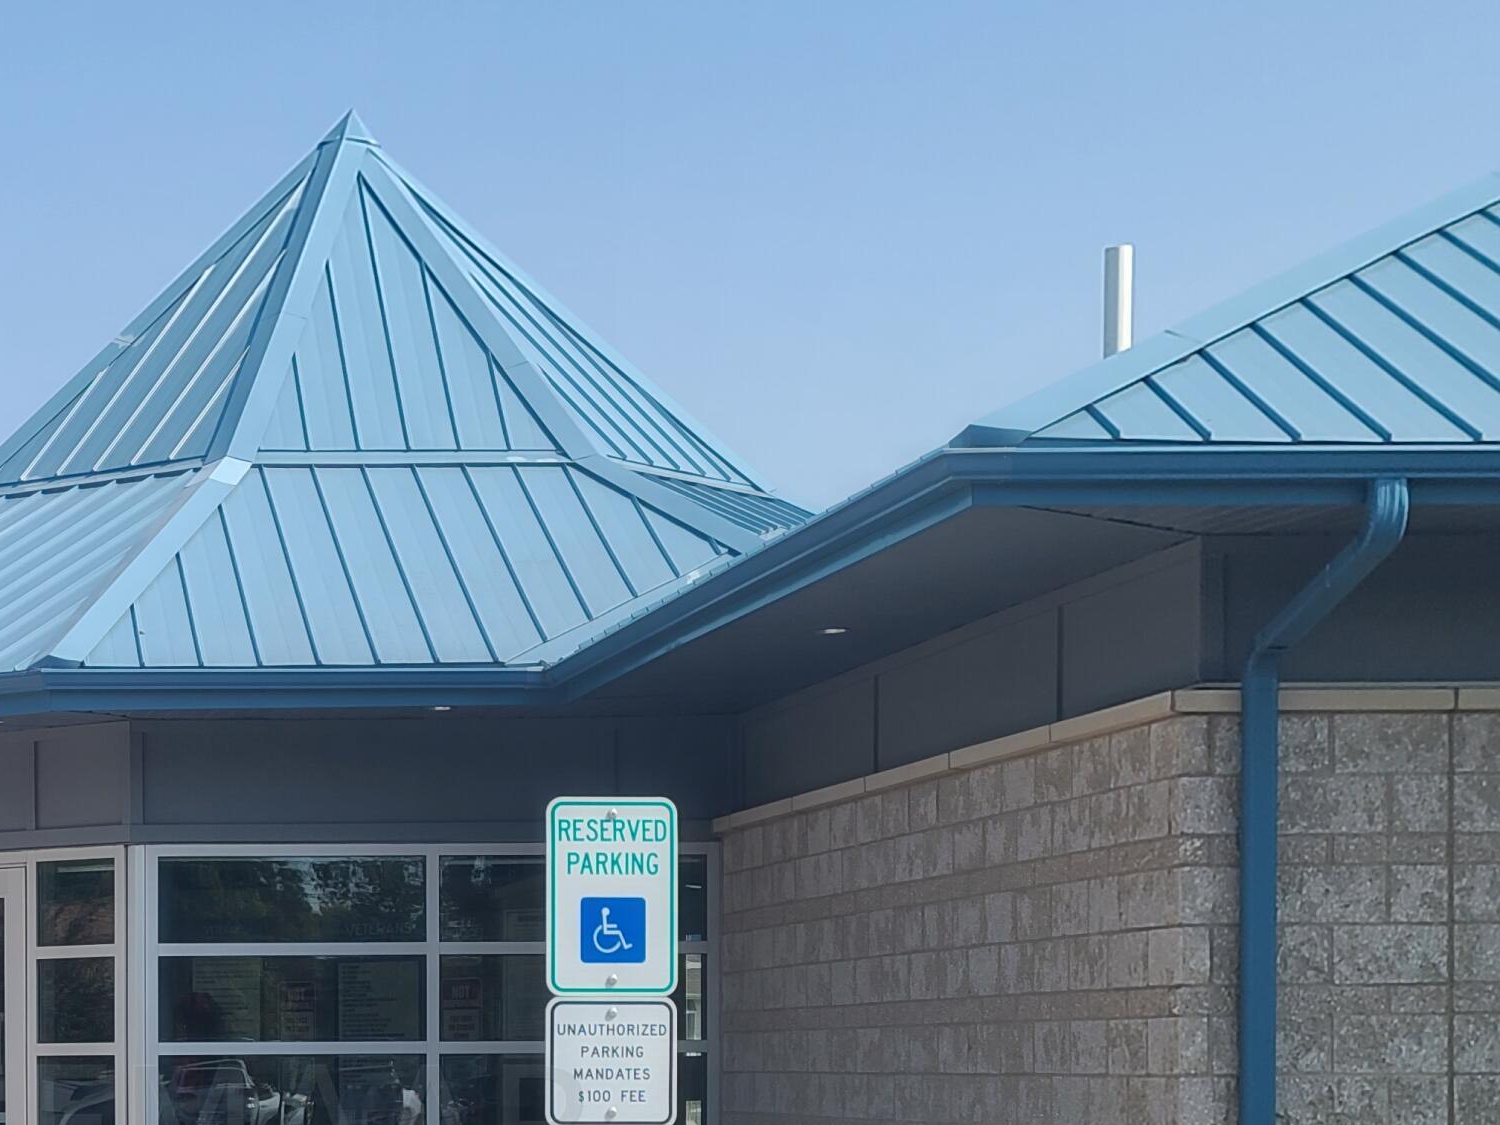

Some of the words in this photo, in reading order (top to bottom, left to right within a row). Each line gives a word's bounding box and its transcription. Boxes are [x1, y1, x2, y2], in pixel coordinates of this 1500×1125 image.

[558, 819, 667, 842] RESERVED
[567, 852, 659, 875] PARKING
[557, 1024, 667, 1037] UNAUTHORIZED
[581, 1046, 644, 1058] PARKING
[573, 1068, 651, 1080] MANDATES
[578, 1090, 611, 1103] $100
[621, 1090, 646, 1102] FEE
